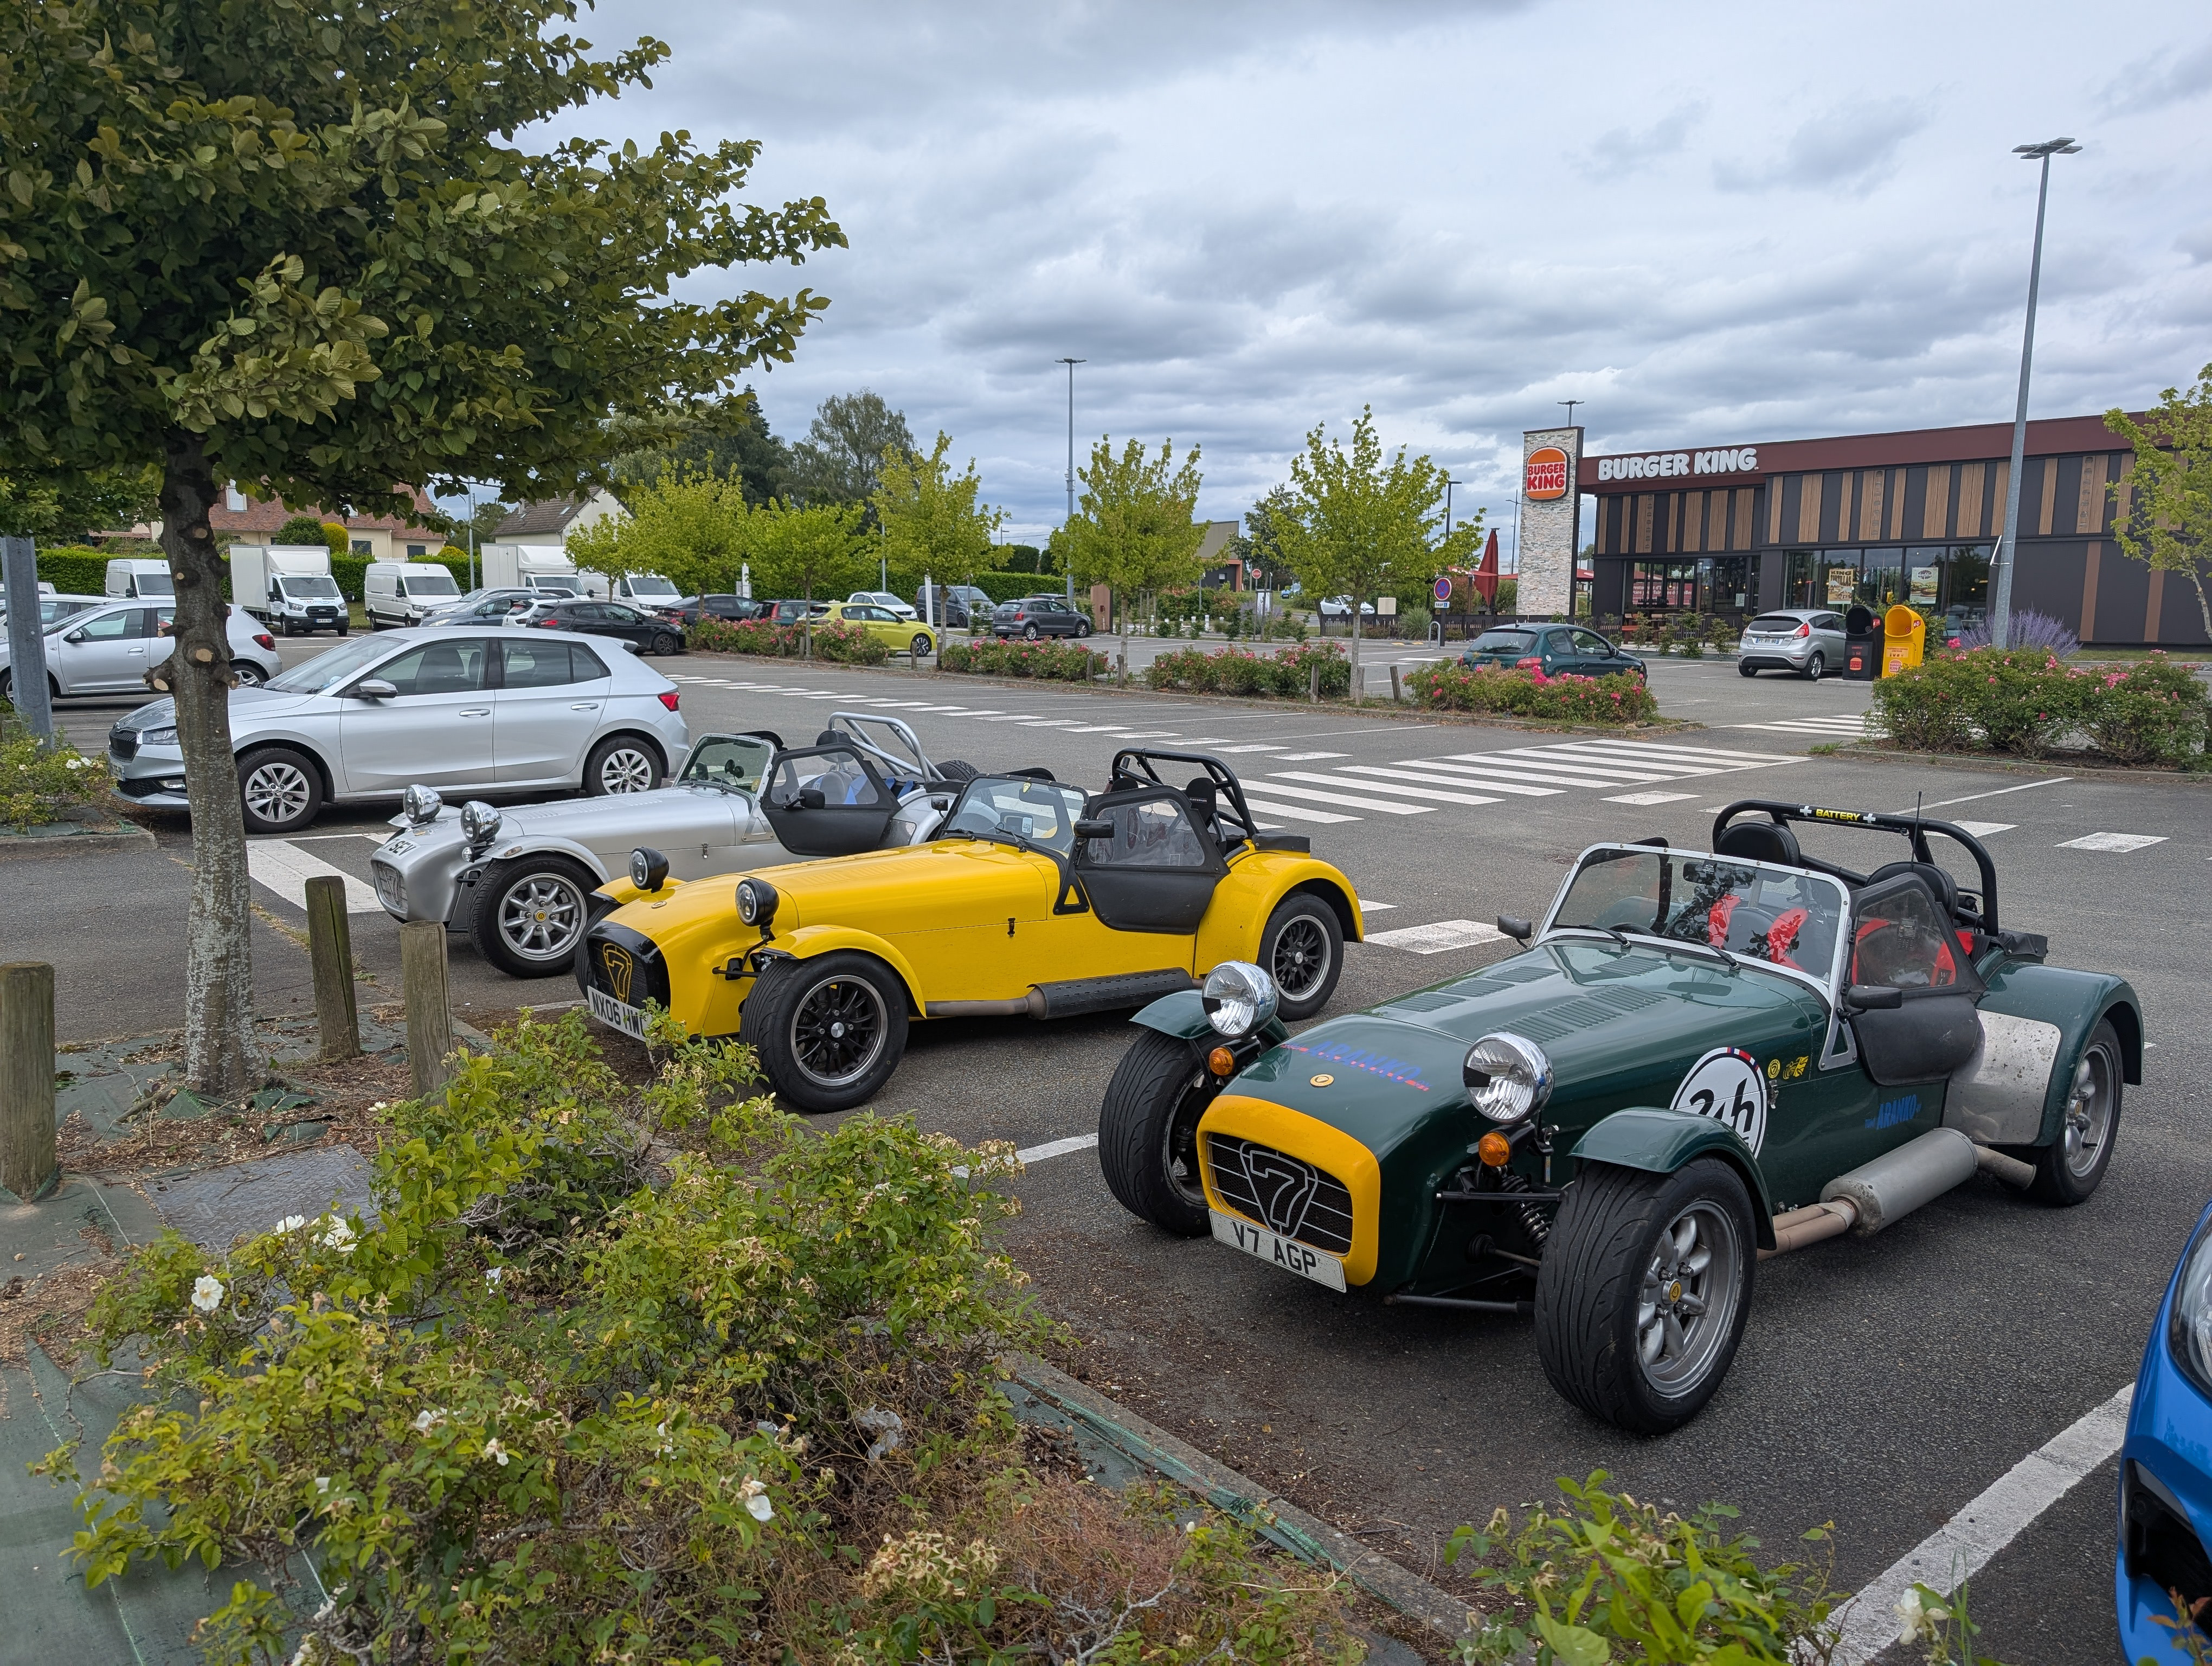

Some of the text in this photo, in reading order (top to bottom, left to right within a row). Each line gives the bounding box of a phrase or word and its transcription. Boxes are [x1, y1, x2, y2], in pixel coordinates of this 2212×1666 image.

[1527, 463, 1565, 476] BURGER
[1598, 447, 1757, 481] BURGER KING
[1527, 474, 1565, 490] KING
[1816, 809, 1861, 821] BATTERY
[591, 991, 621, 1026] NX06
[1250, 1149, 1308, 1228] 7
[1231, 1221, 1317, 1276] V7 AGP
